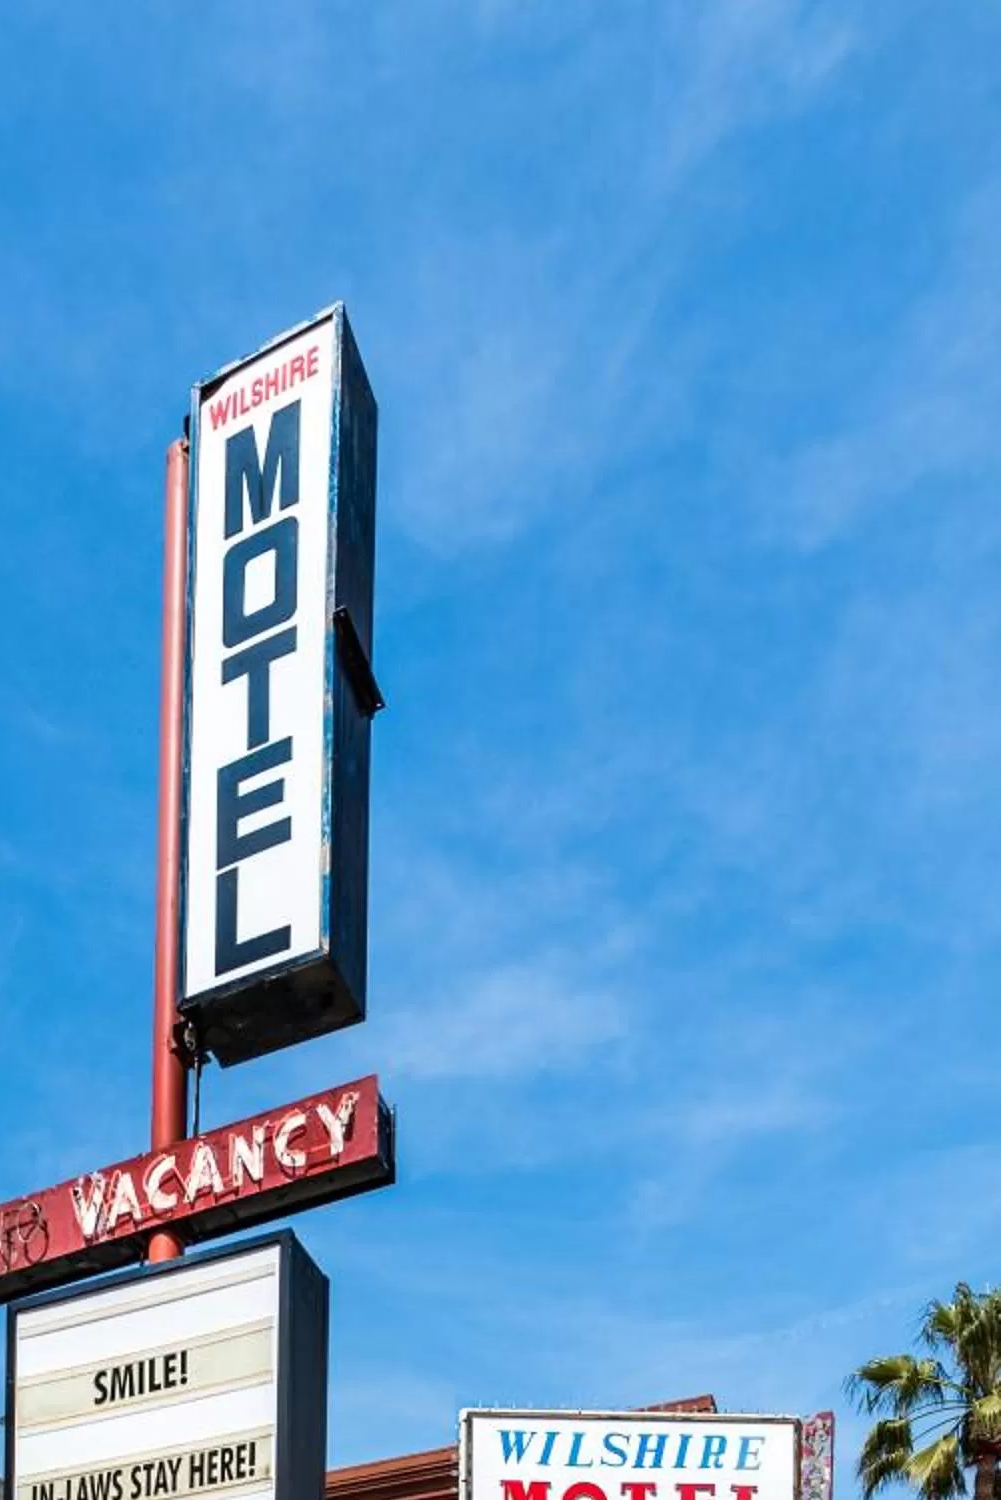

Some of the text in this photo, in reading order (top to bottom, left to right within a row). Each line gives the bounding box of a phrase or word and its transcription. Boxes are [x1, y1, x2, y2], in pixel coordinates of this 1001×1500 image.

[209, 346, 320, 430] WILSHIRE
[214, 397, 302, 977] MOTEL
[70, 1090, 361, 1239] VACANCY
[93, 1349, 189, 1406] SMILE!
[130, 1456, 183, 1500] STAY
[188, 1441, 257, 1489] HERE!
[498, 1429, 767, 1471] WILSHIRE
